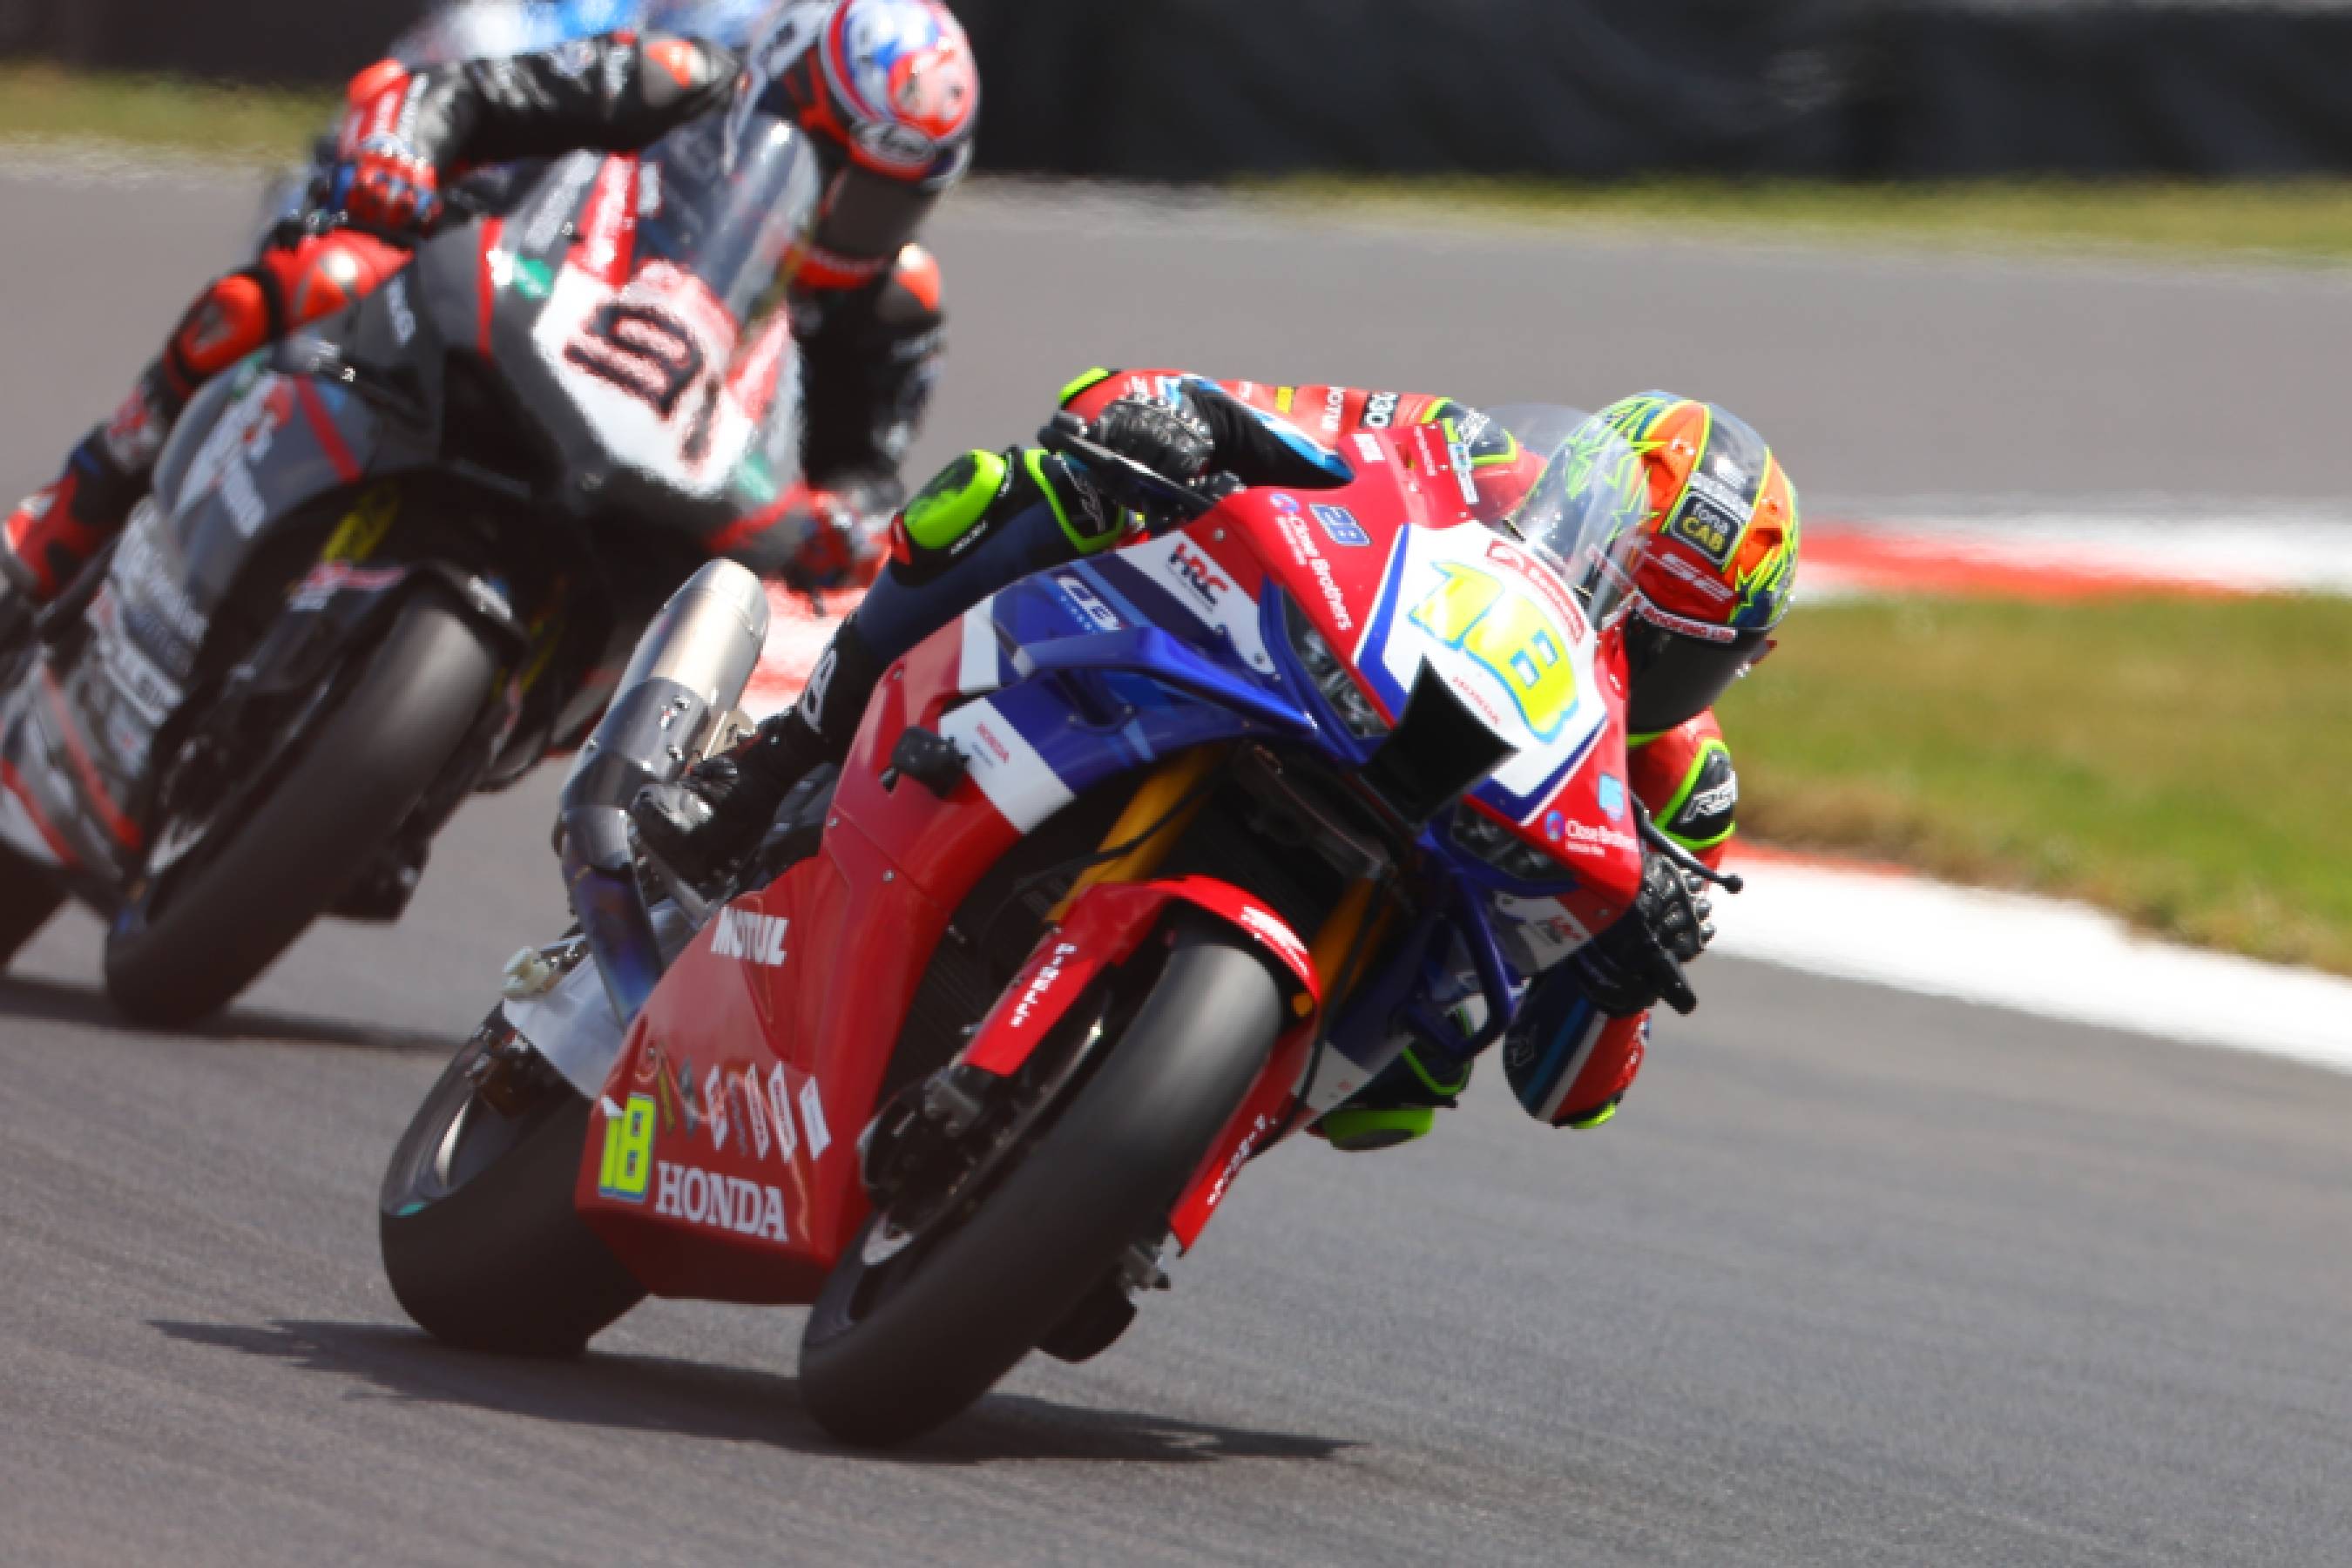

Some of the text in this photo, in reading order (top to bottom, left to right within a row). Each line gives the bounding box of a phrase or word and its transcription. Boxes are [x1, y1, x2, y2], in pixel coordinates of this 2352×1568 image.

[1681, 516, 1727, 551] CAB
[1168, 542, 1232, 605] HRC
[1310, 558, 1354, 631] Brothers
[1406, 558, 1580, 746] 18
[710, 904, 789, 965] MOTUL
[598, 1091, 657, 1203] 18
[655, 1160, 789, 1242] HONDA
